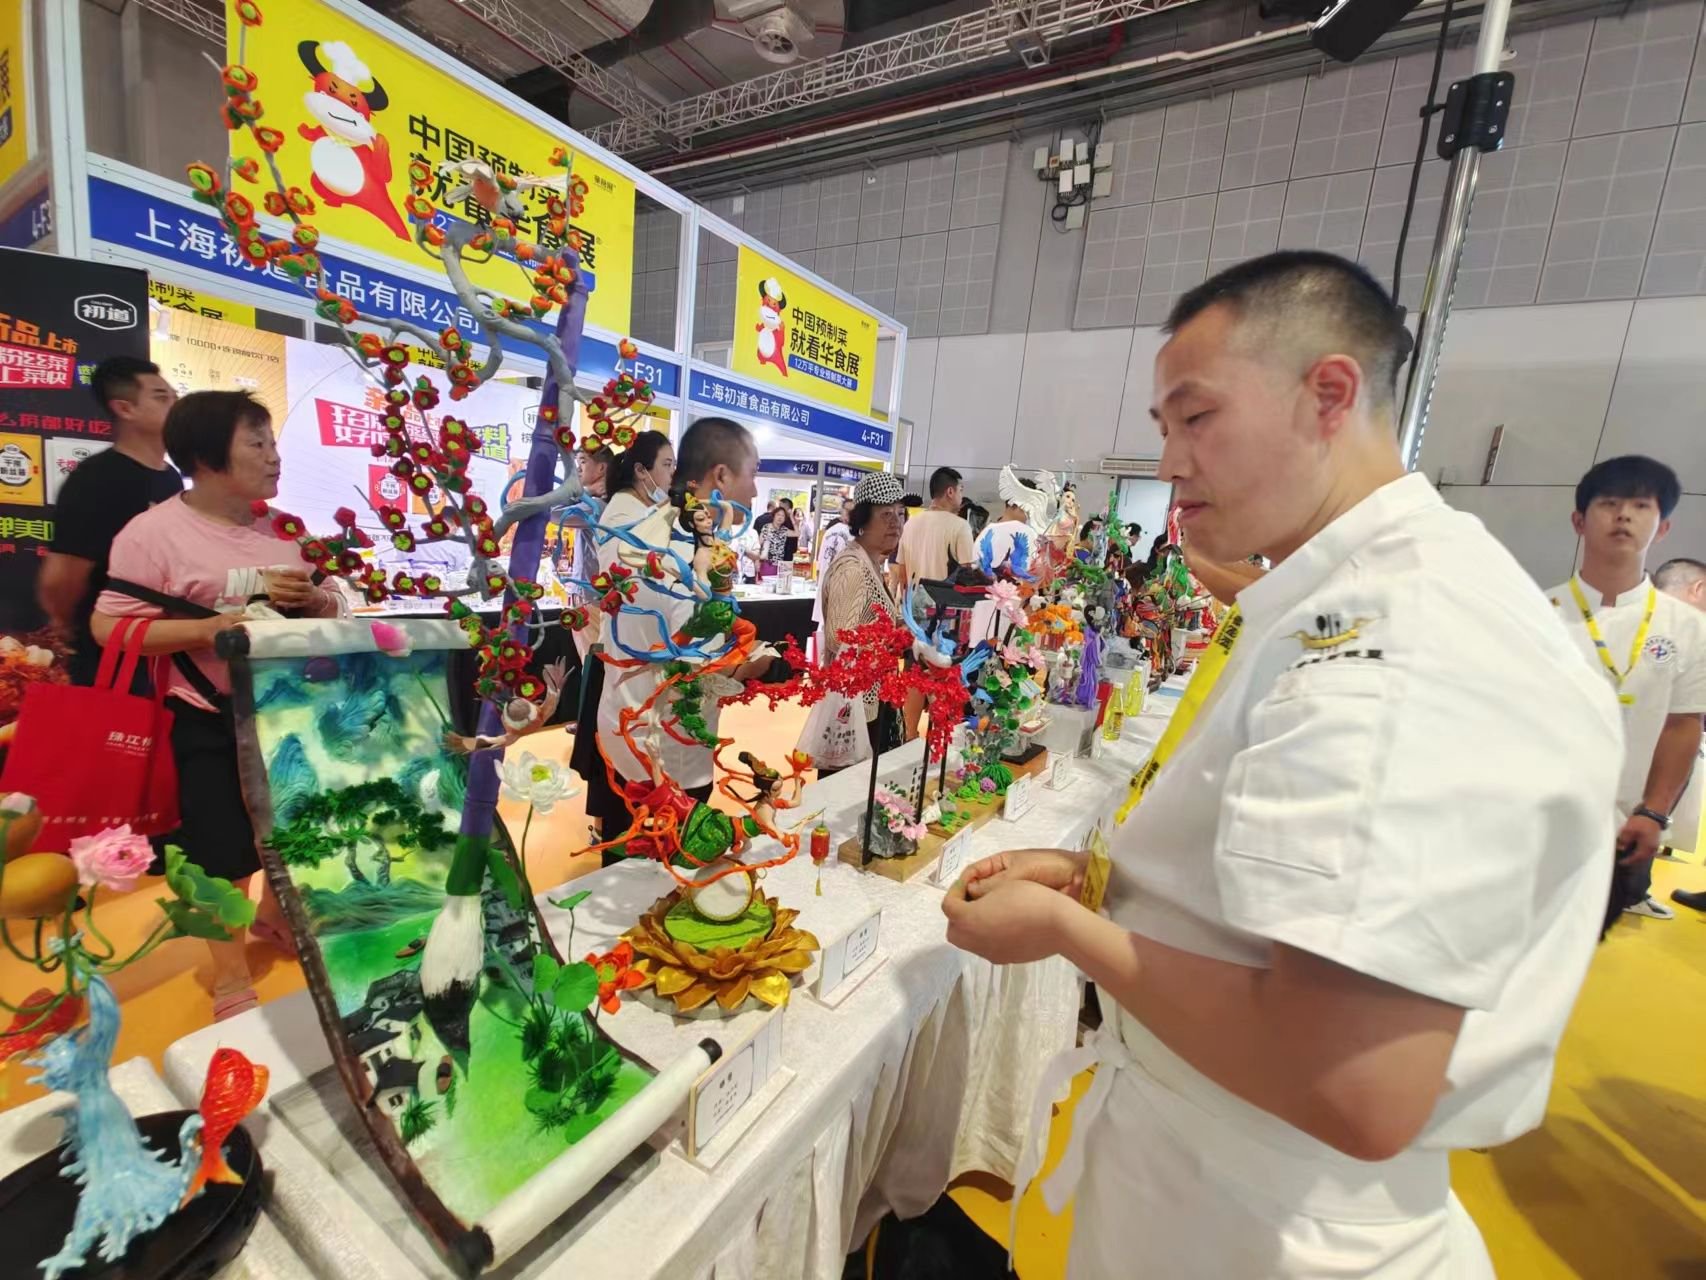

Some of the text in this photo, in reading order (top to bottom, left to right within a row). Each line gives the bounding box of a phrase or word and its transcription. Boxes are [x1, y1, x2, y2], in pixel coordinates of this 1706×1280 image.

[409, 152, 595, 269] 就看食展
[82, 304, 130, 323] 初道
[792, 307, 848, 347] 中国预制菜
[790, 328, 860, 377] 就看华食展
[614, 359, 662, 386] 4-F31
[698, 380, 810, 426] 上海初道食品有限公司
[861, 429, 884, 447] 4-F31
[793, 464, 814, 472] 4-F74
